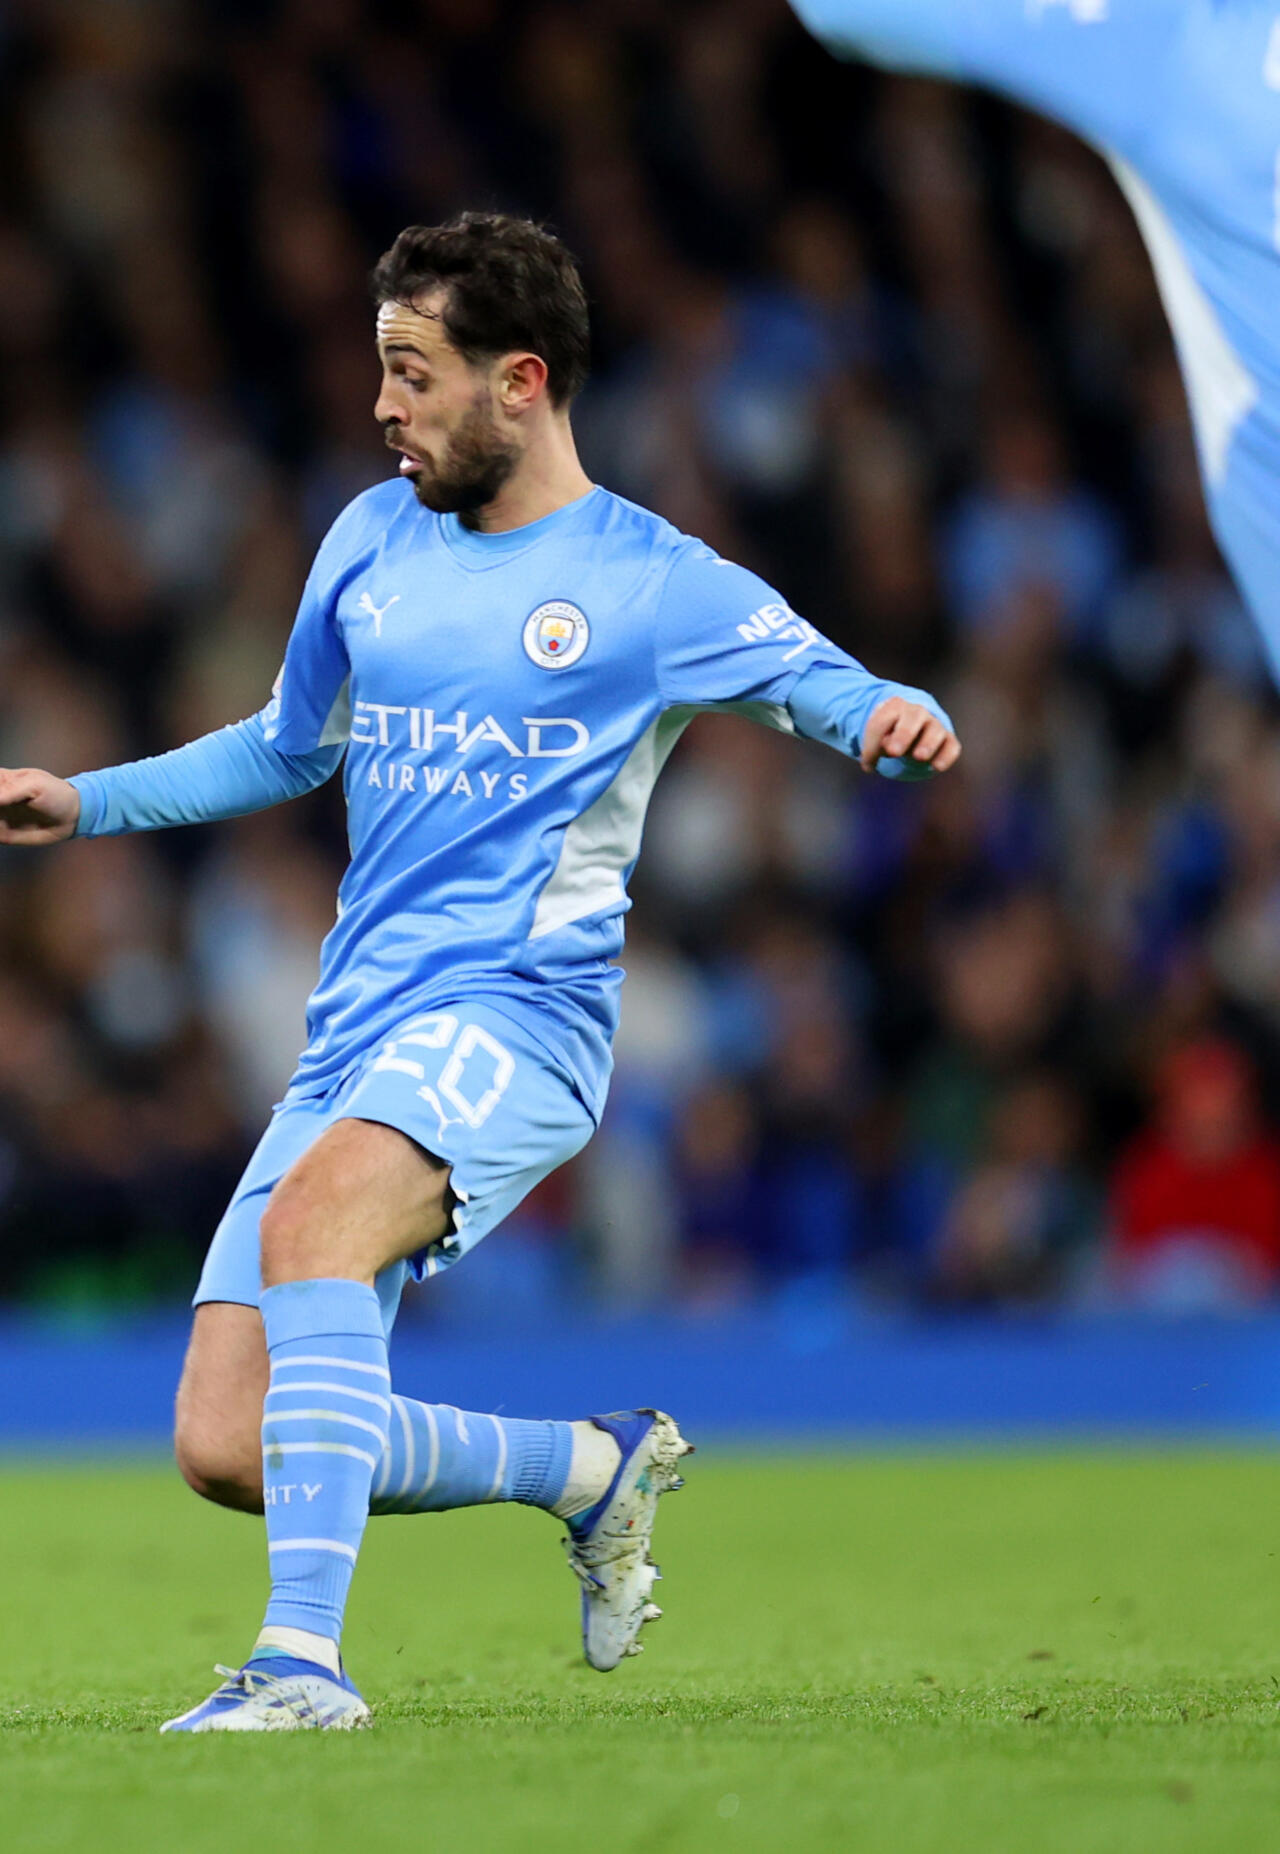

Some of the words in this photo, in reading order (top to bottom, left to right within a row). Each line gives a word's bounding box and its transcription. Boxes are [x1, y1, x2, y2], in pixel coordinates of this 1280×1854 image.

[350, 700, 590, 758] ETIHAD
[368, 761, 529, 801] AIRWAYS
[372, 1013, 516, 1129] 20
